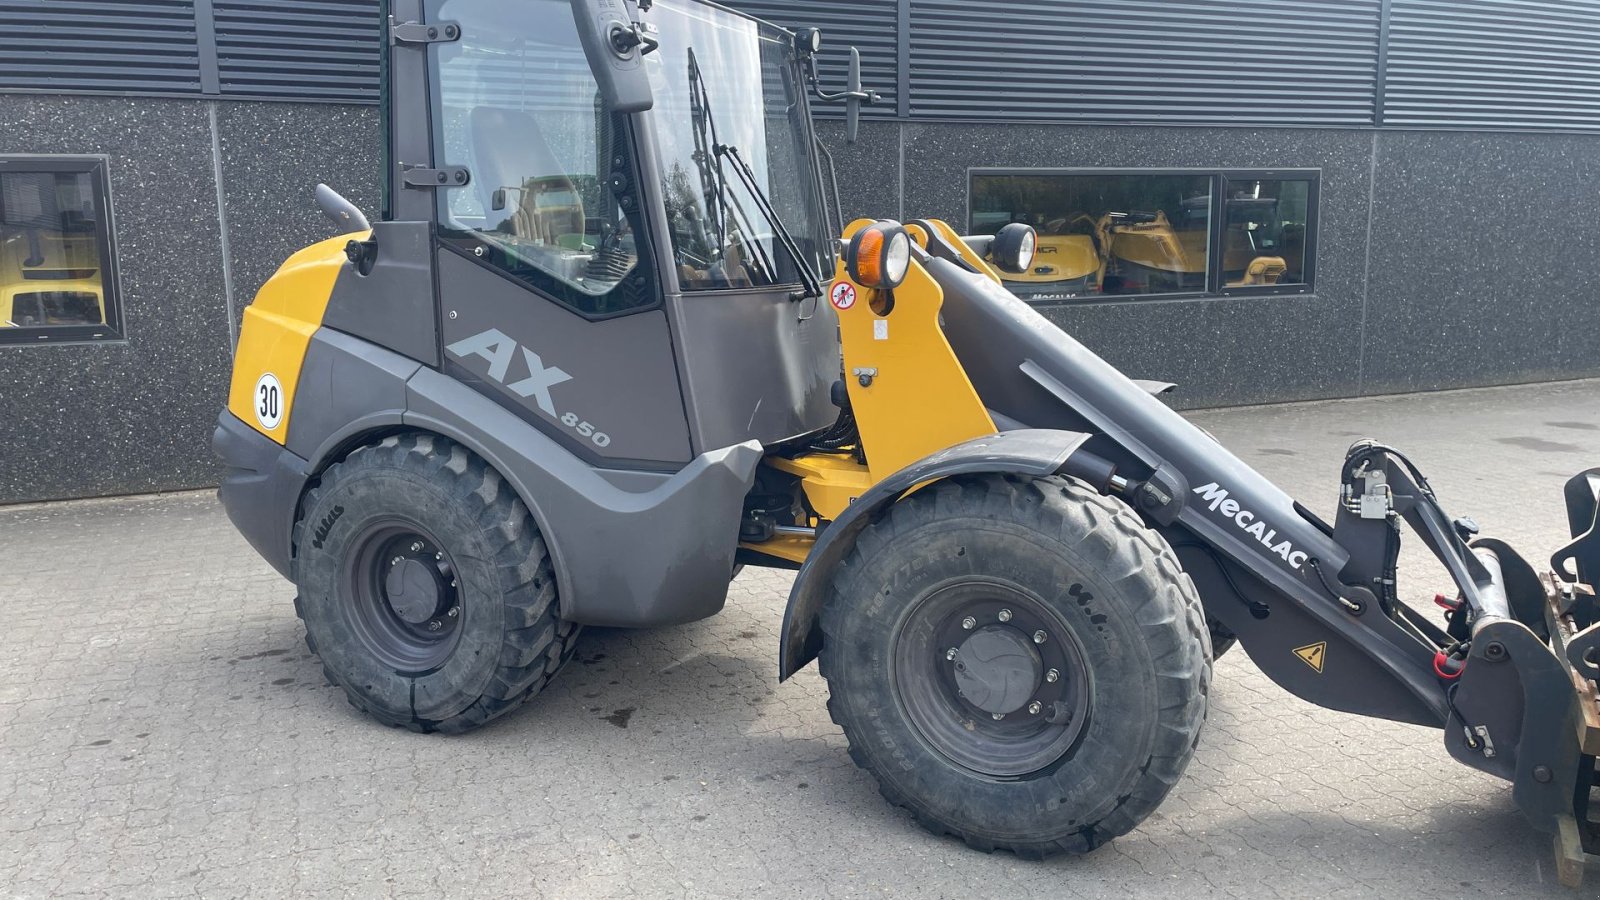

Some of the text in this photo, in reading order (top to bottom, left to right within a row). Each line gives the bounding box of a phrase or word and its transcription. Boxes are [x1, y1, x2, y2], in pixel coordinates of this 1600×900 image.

[446, 328, 574, 419] AX
[260, 384, 278, 419] 30
[560, 412, 611, 447] 850
